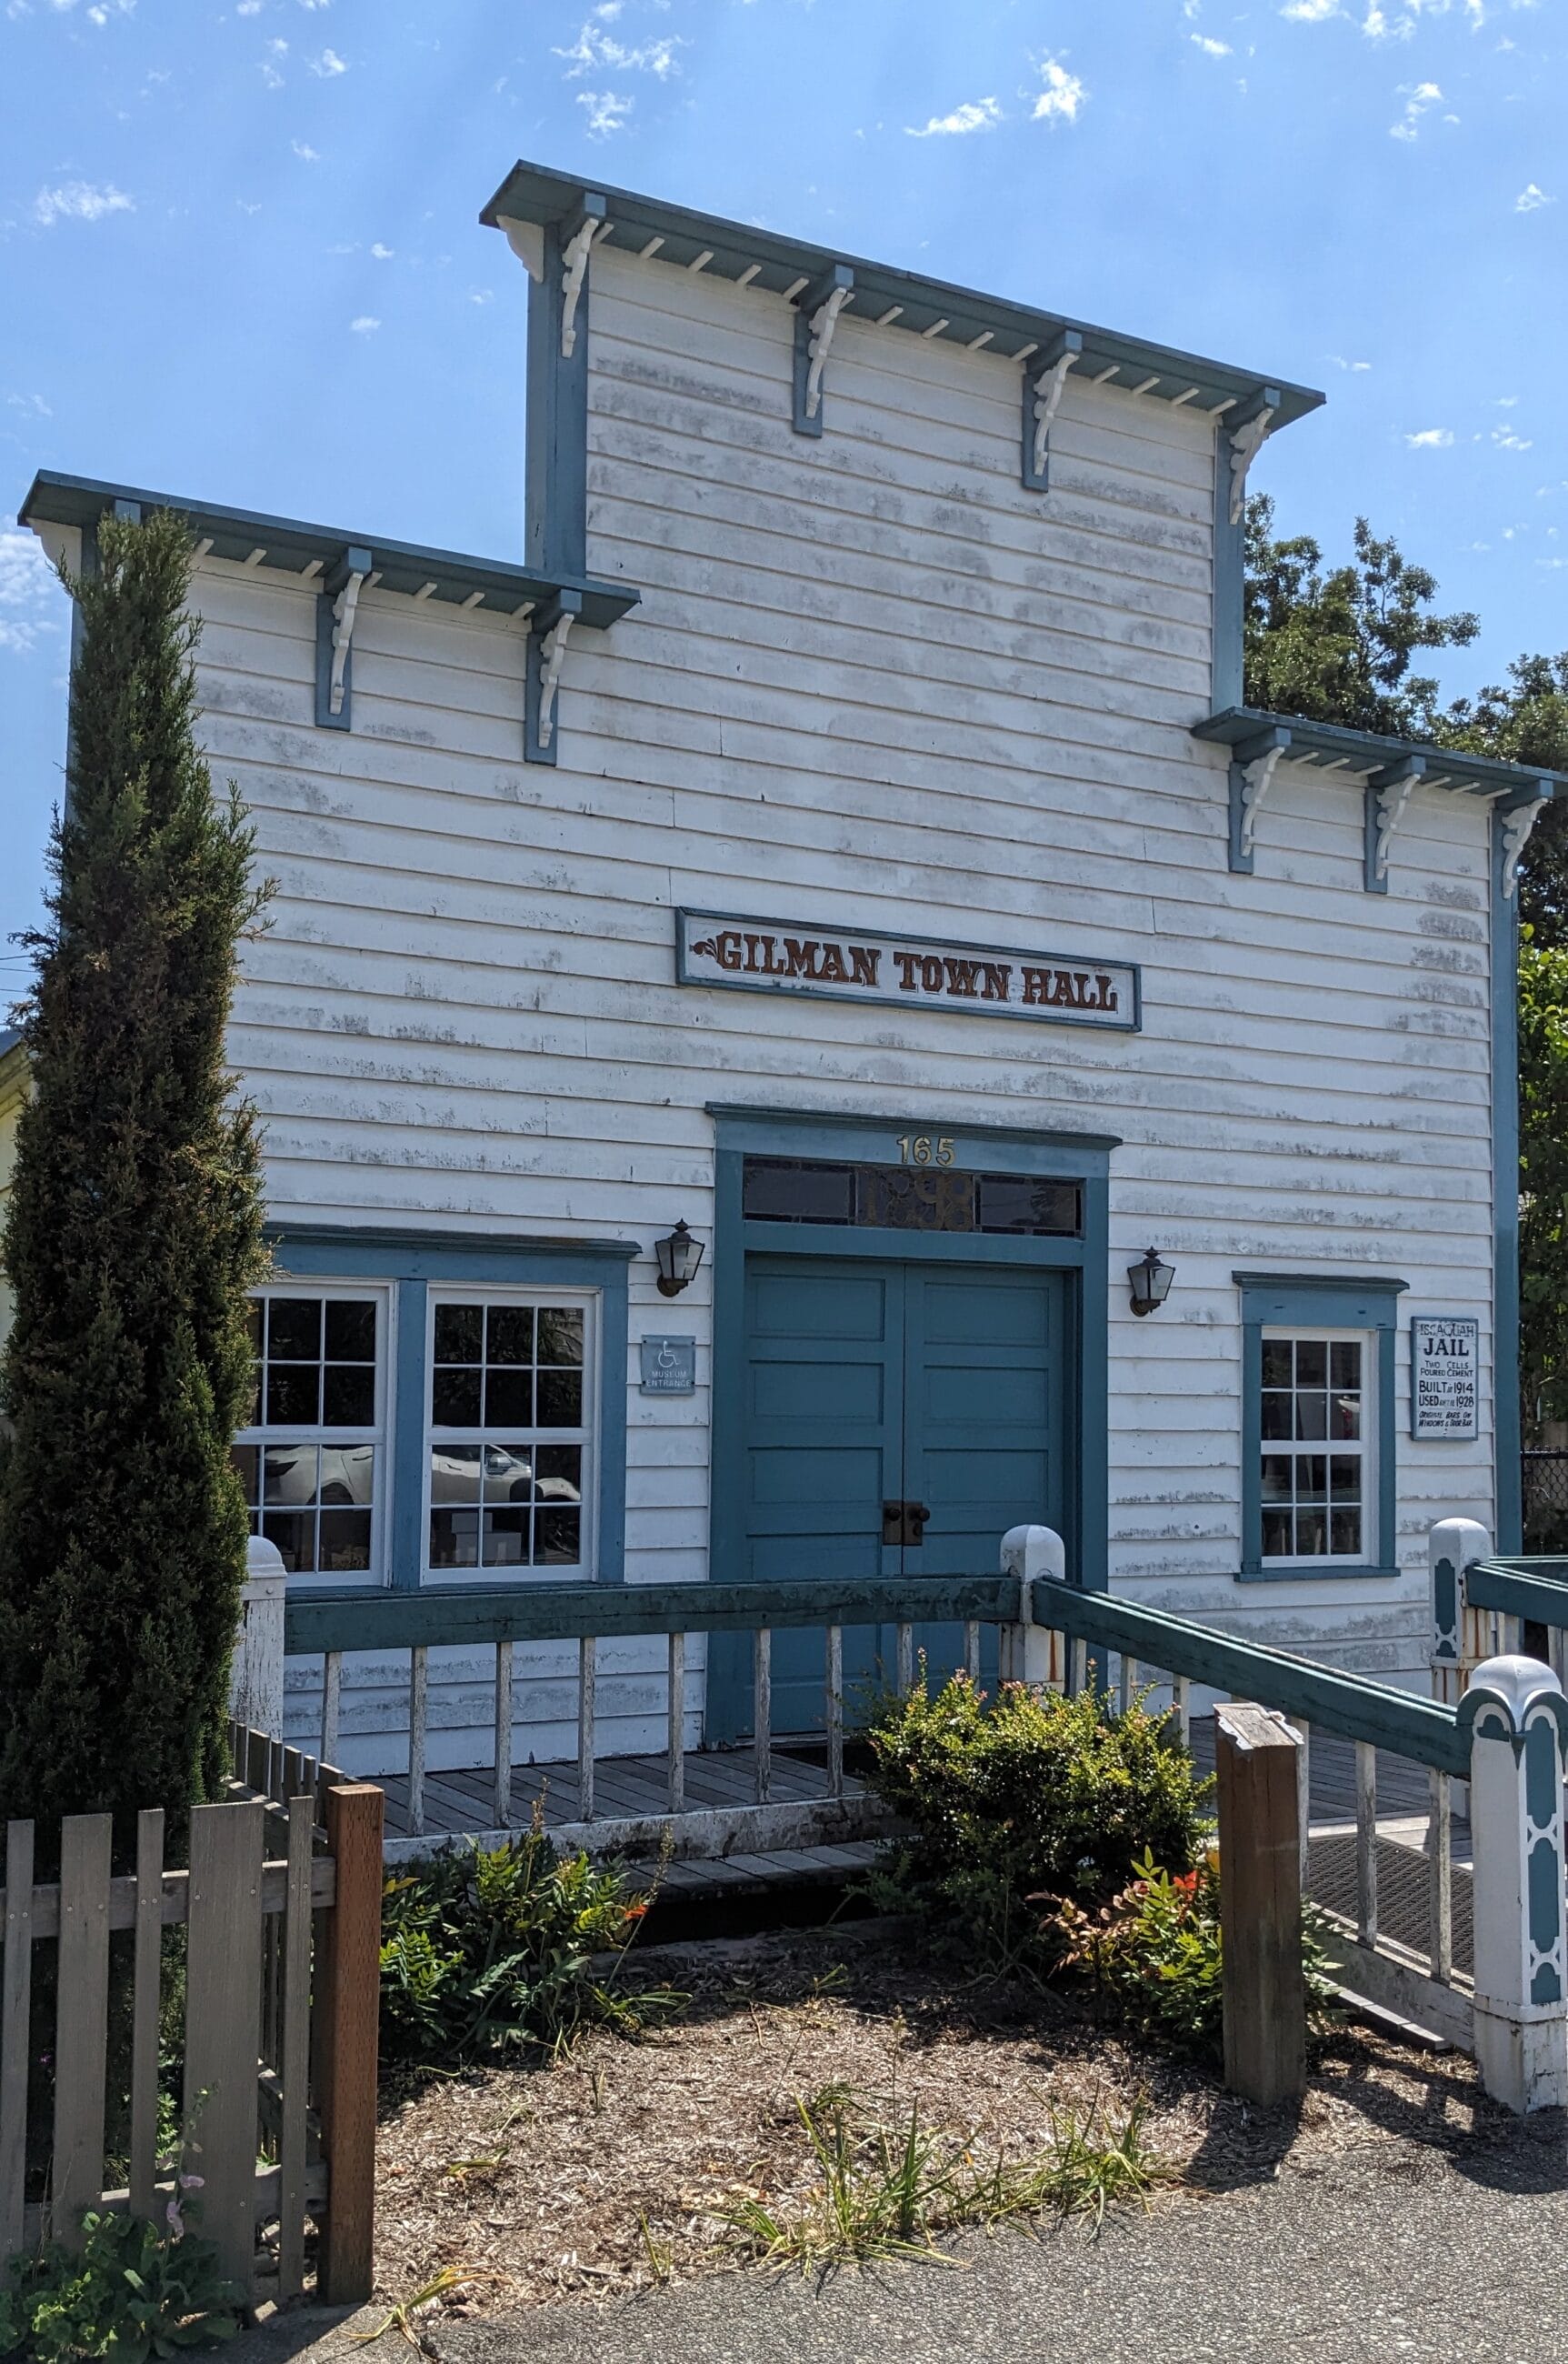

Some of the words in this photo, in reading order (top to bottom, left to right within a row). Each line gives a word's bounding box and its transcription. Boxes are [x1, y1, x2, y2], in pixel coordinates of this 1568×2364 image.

[716, 930, 882, 987] GILMAN
[894, 950, 1013, 1002] TOWN
[1020, 965, 1119, 1013] HALL
[896, 1135, 955, 1167] 165
[1419, 1323, 1474, 1337] ISSAQUAH
[1423, 1337, 1469, 1357] JAIL
[1420, 1367, 1446, 1377] POURED
[1446, 1368, 1474, 1377] CEMENT
[1424, 1360, 1441, 1369] TWO
[1446, 1360, 1469, 1370] CELLS
[651, 1370, 687, 1378] MUSEUM
[646, 1379, 692, 1387] ENTRANCE
[1419, 1379, 1448, 1394] BUILT
[1453, 1381, 1474, 1395] 1914
[1418, 1394, 1440, 1407] USED
[1456, 1396, 1474, 1408] 1928
